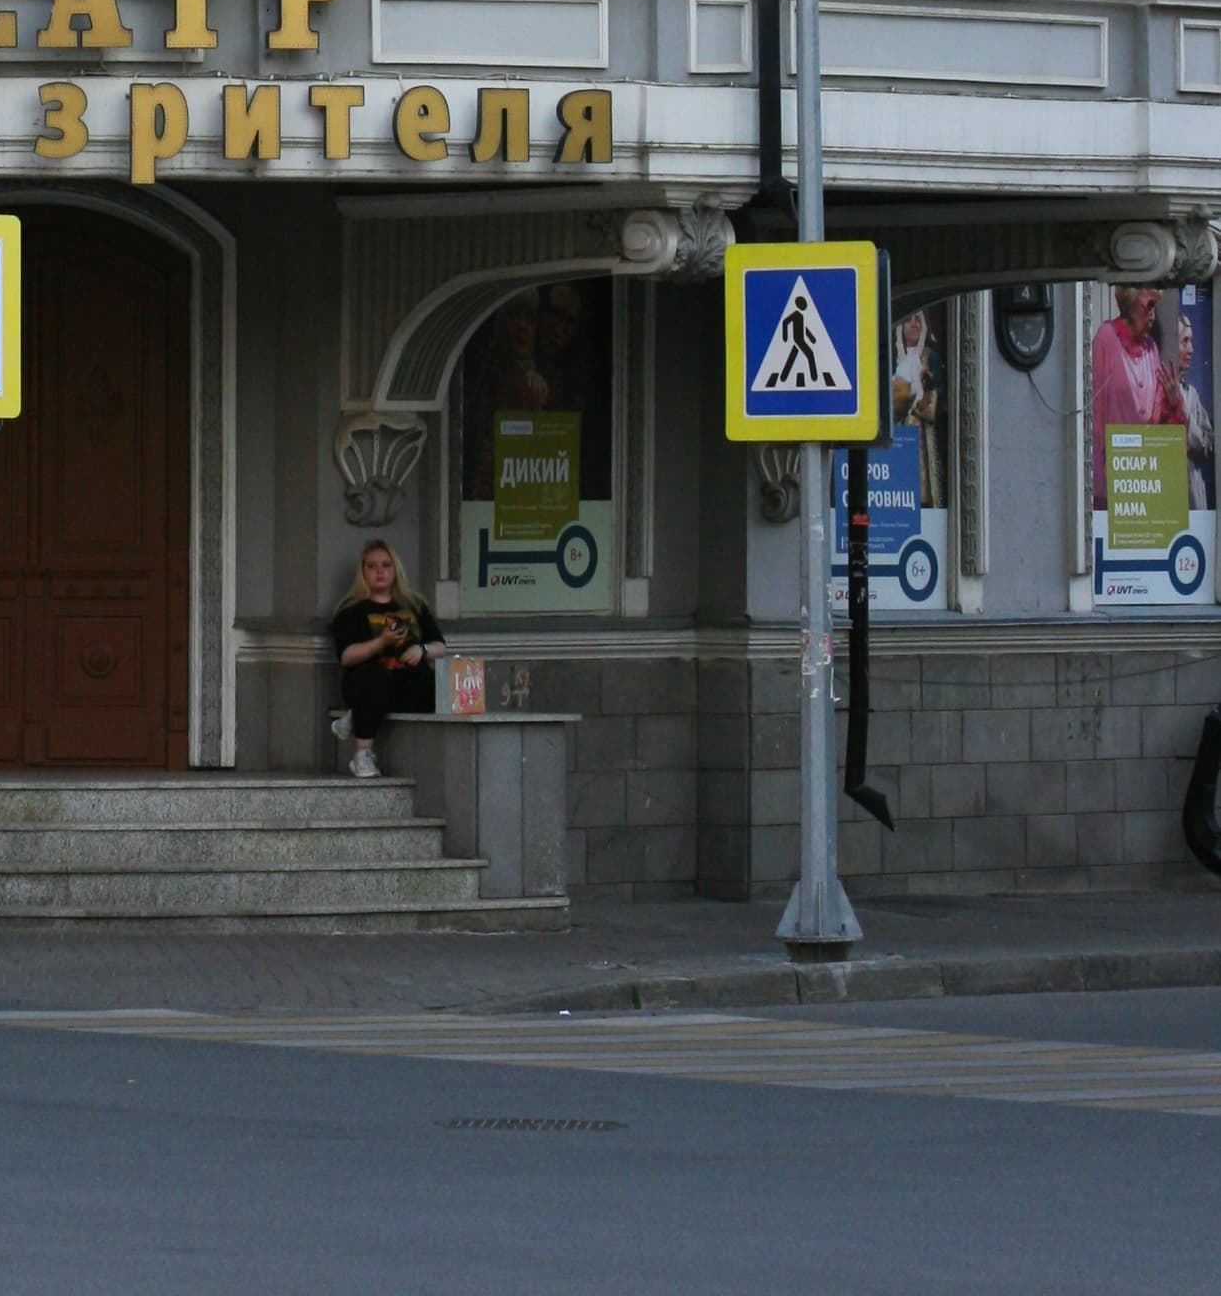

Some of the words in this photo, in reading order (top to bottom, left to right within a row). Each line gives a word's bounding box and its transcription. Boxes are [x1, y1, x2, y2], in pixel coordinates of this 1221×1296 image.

[499, 450, 570, 489] ДИКИЙ
[1113, 456, 1147, 471] ОСКАР
[1149, 457, 1157, 470] И
[841, 463, 890, 481] ОРОВ
[1113, 479, 1161, 494] РОЗОВАЯ
[842, 490, 915, 511] СРОВИЩ
[1114, 502, 1147, 517] МАМА
[911, 561, 926, 577] 6+
[1179, 558, 1196, 571] 12+
[501, 575, 519, 585] UVT
[1116, 585, 1133, 595] UVT
